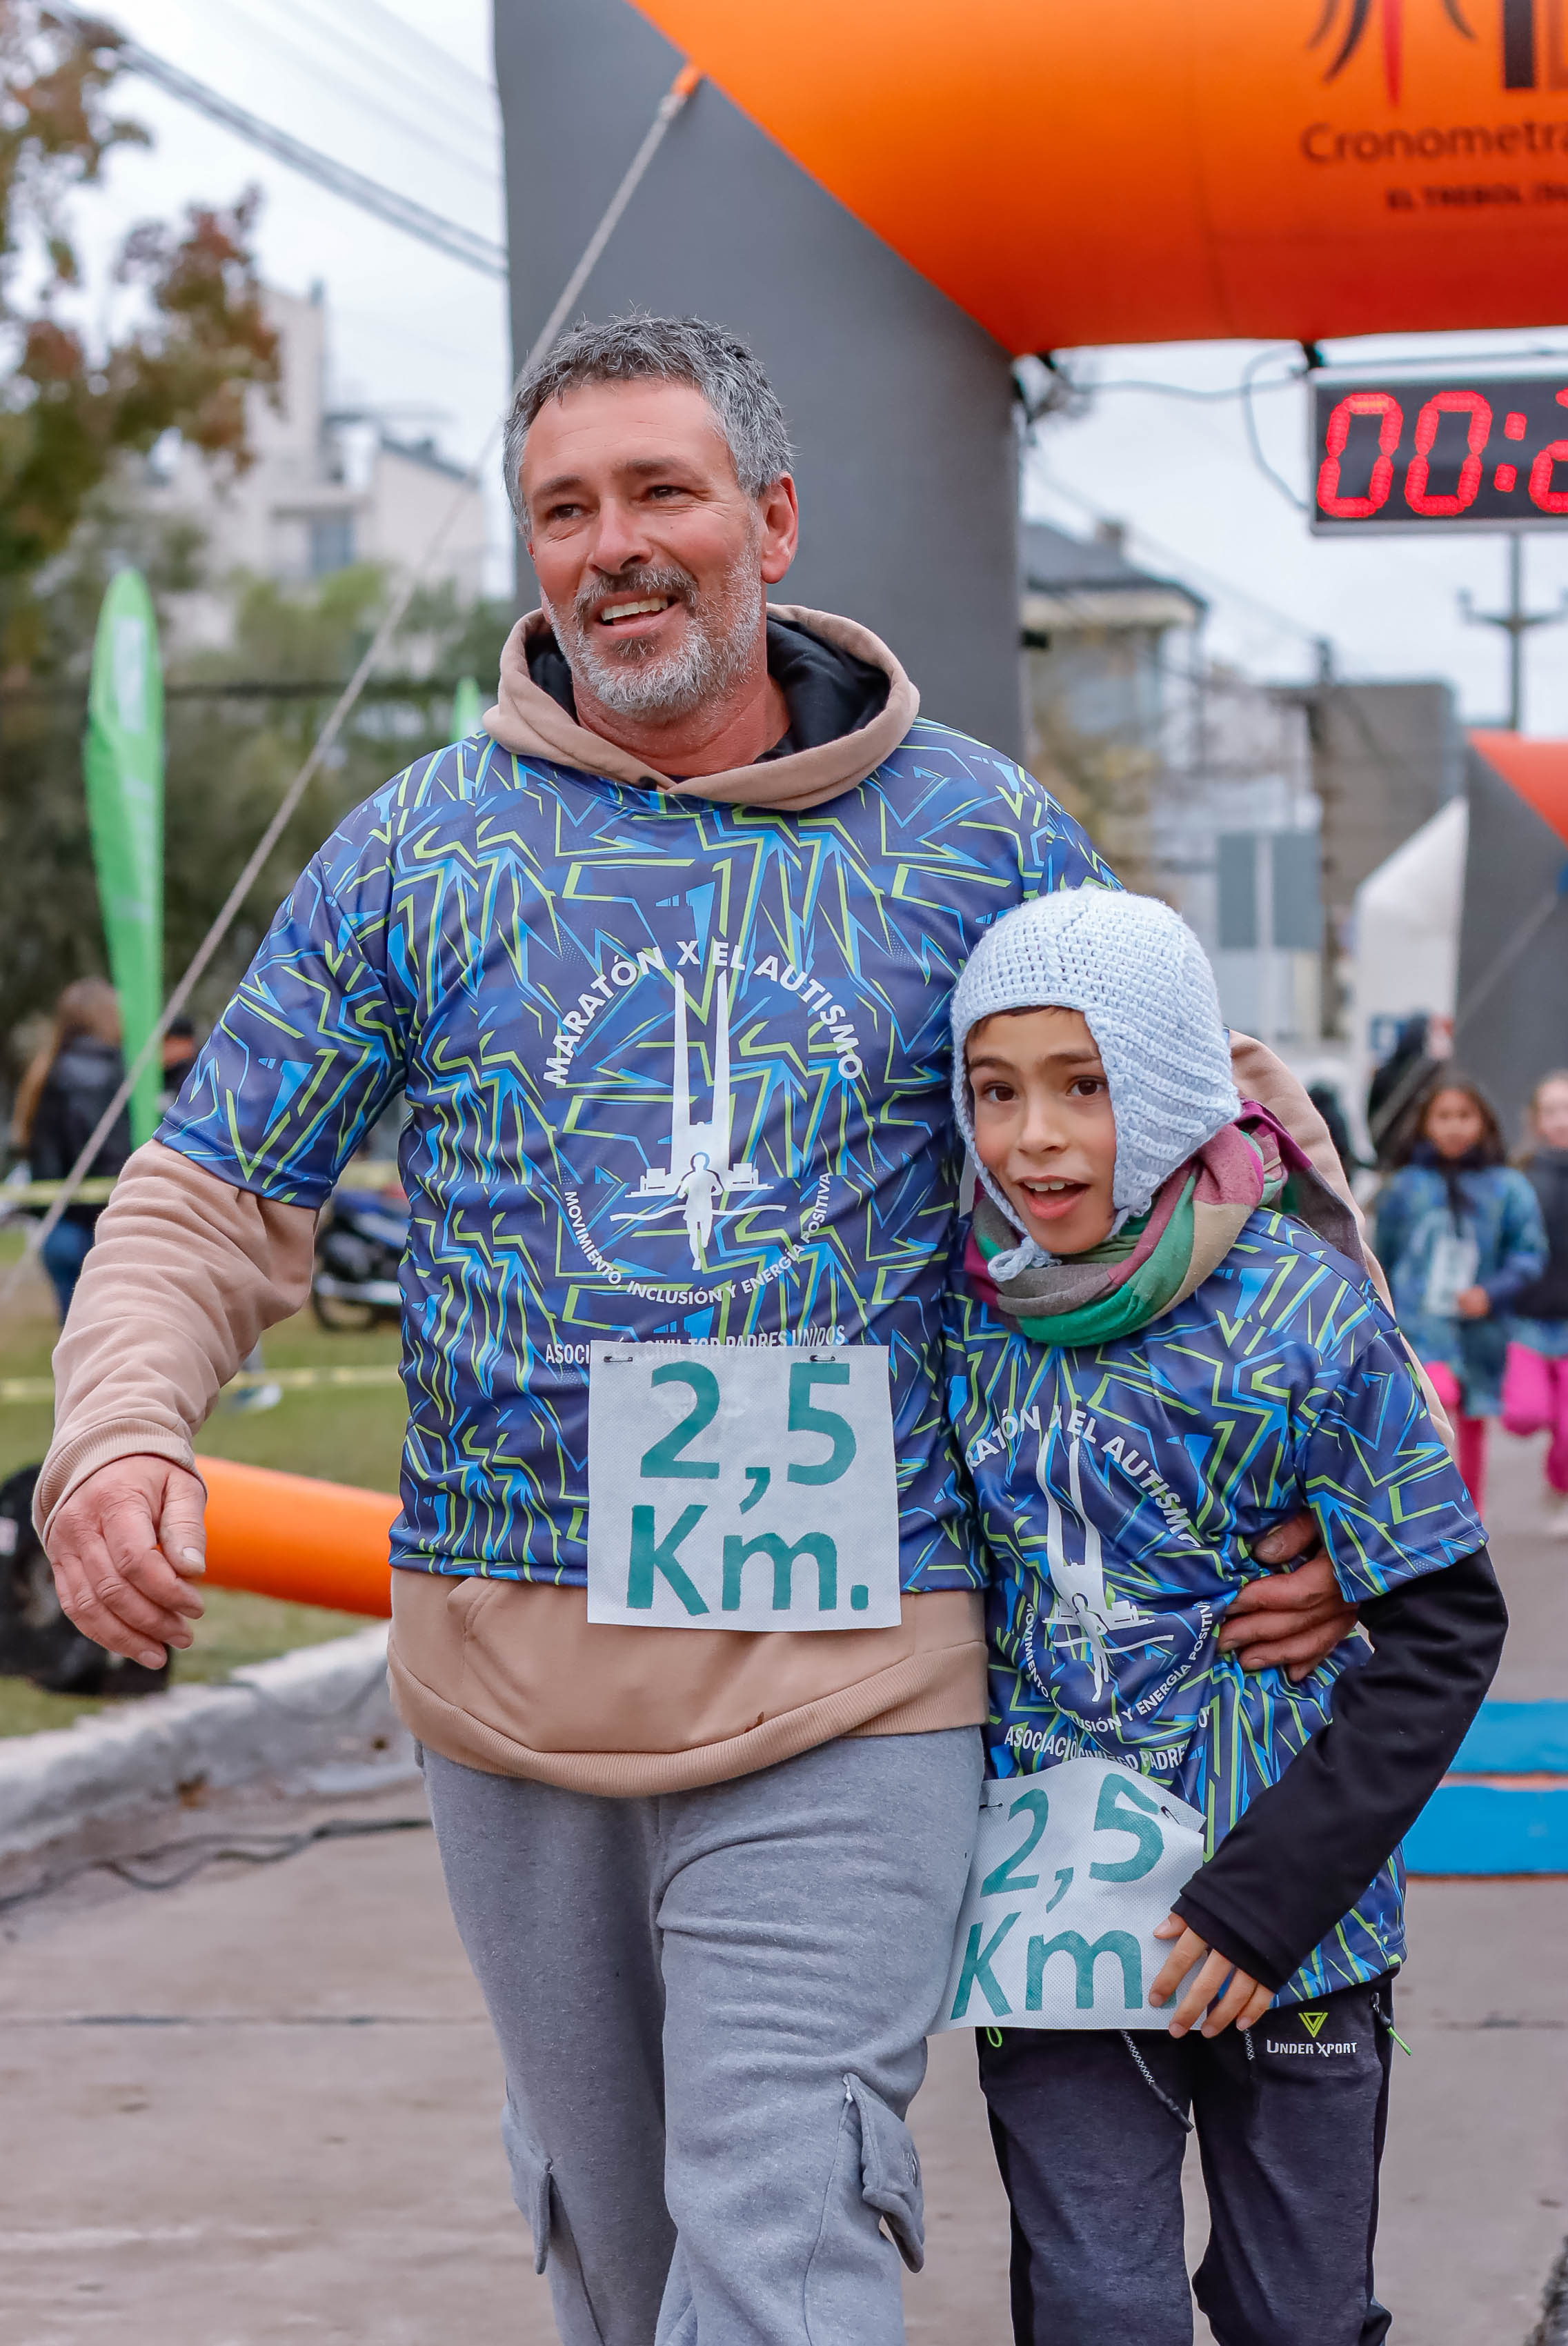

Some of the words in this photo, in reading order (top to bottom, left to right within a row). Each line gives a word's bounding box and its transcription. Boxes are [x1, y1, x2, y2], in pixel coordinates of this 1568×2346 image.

[544, 946, 666, 1086] MARATÓN
[677, 940, 700, 966] X
[711, 942, 746, 971] EL
[753, 955, 863, 1080] AUTISMO
[564, 1191, 622, 1289] MOVIMIENTO,
[626, 1280, 723, 1304] INCLUSIÓN
[724, 1286, 737, 1298] Y
[741, 1244, 805, 1294] ENERGÍA
[800, 1173, 831, 1243] POSITIVA
[640, 1361, 857, 1514] 2,5
[1066, 1413, 1098, 1444] EL
[626, 1504, 869, 1616] Km.
[1121, 1707, 1133, 1721] Y
[1135, 1664, 1192, 1716] ENERGÍA
[980, 1773, 1164, 1913] 2,5
[1267, 2040, 1314, 2054] UNDER
[1316, 2042, 1358, 2058] XPORT
